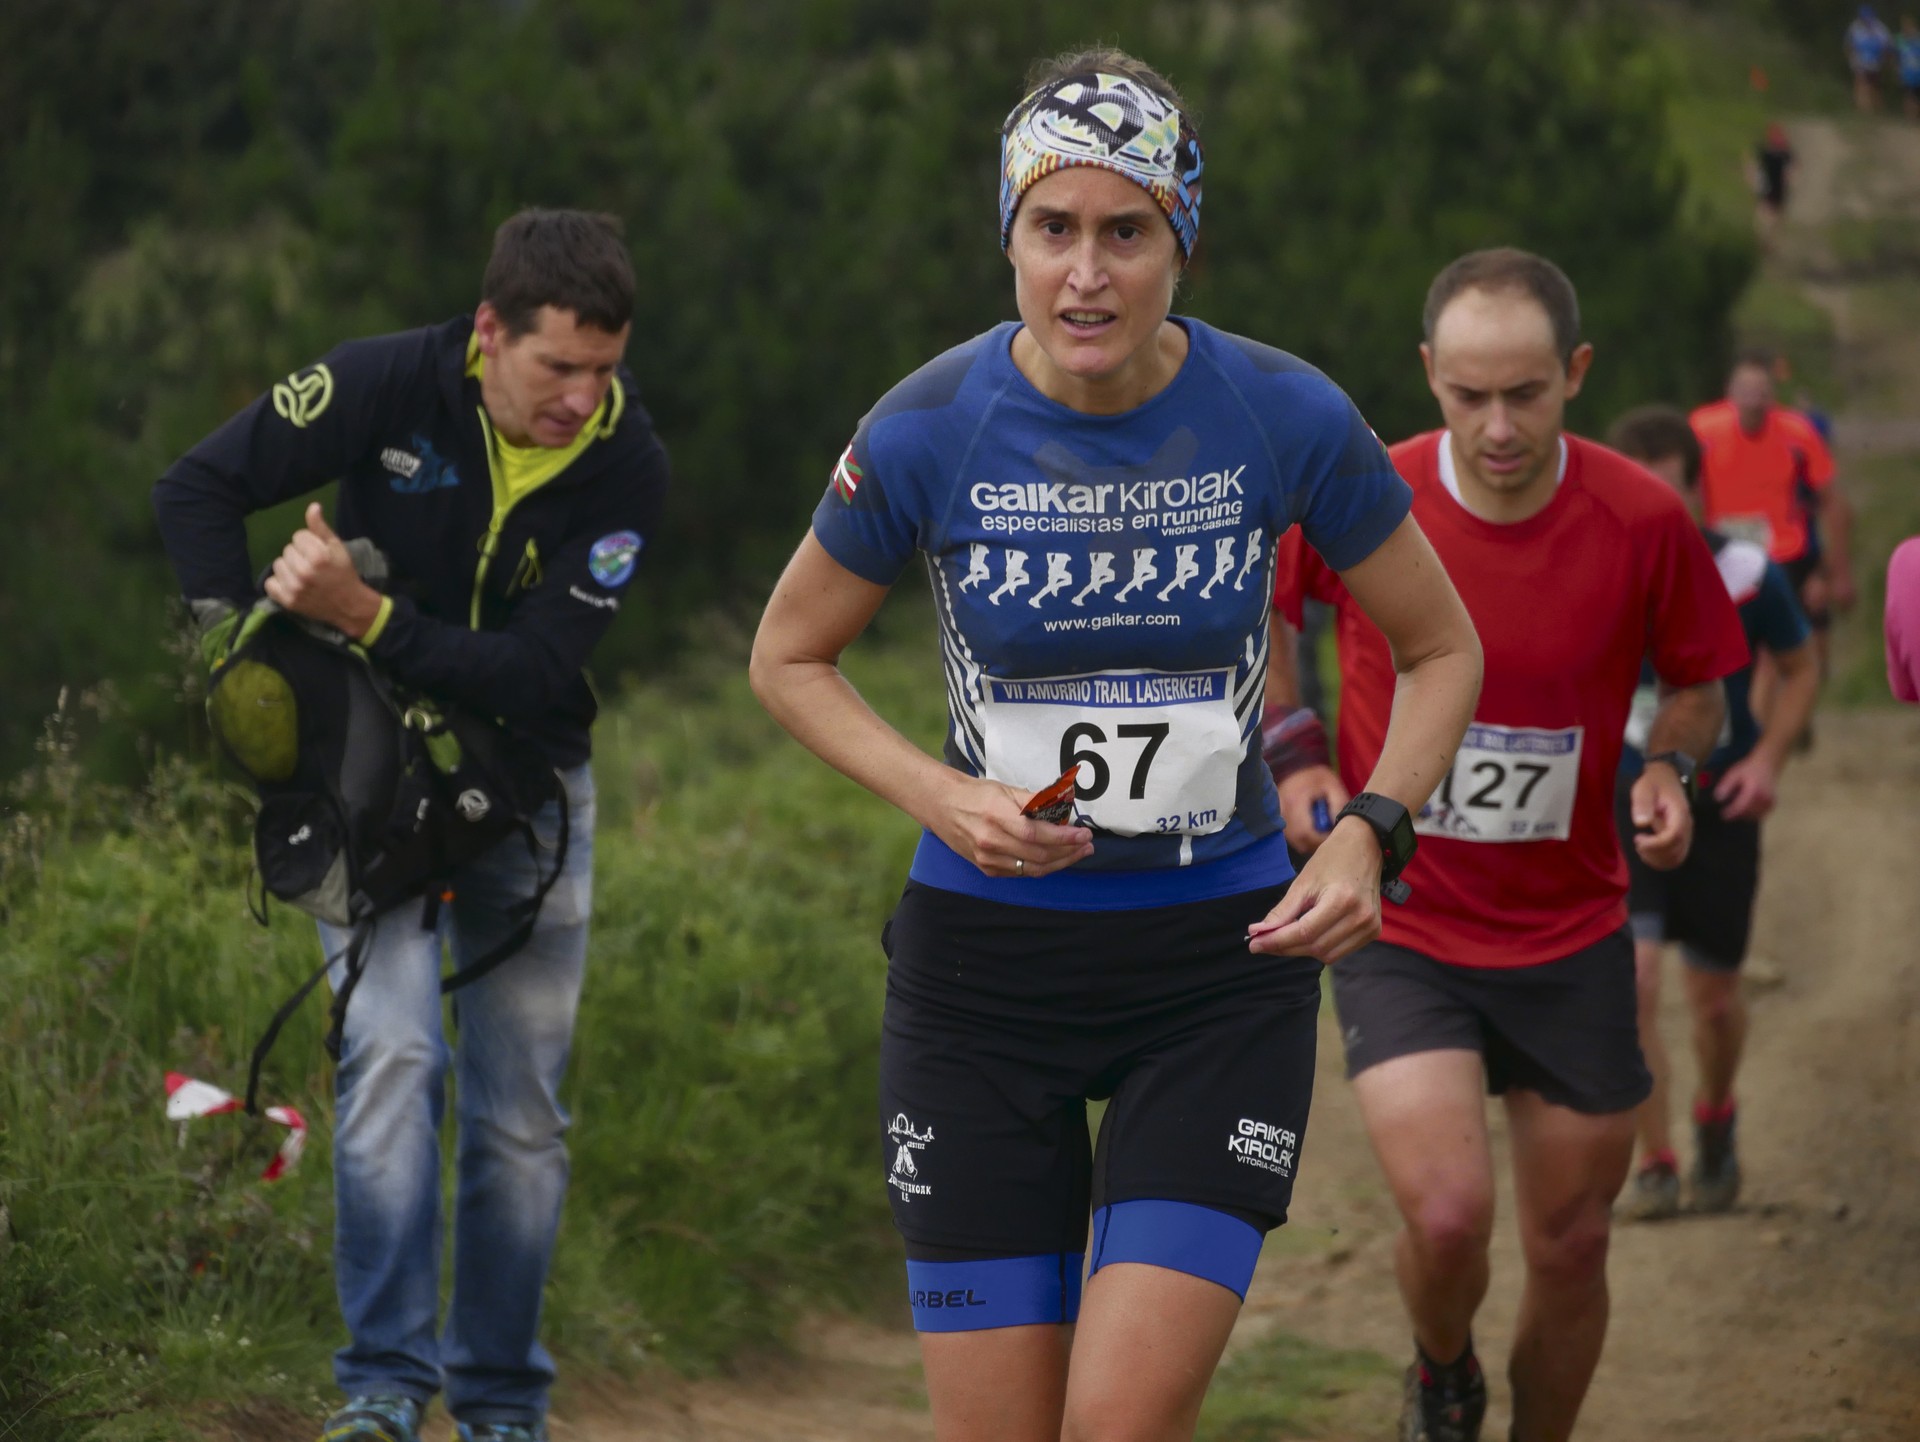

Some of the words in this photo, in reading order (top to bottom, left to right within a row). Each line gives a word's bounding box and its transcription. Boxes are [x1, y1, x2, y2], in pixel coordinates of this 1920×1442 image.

[981, 515, 1124, 536] especialistas
[1131, 512, 1158, 530] en
[1043, 612, 1181, 633] www.gaikar.com
[1003, 683, 1023, 700] VII
[1027, 680, 1091, 702] AMURRIO
[1094, 680, 1133, 704] TRAIL
[1136, 675, 1213, 704] LASTERKETA
[1059, 721, 1170, 802] 67
[1156, 815, 1181, 834] 32
[1188, 808, 1218, 830] km
[1237, 1118, 1297, 1150] GAIKAR
[1227, 1134, 1294, 1169] KIROLAK
